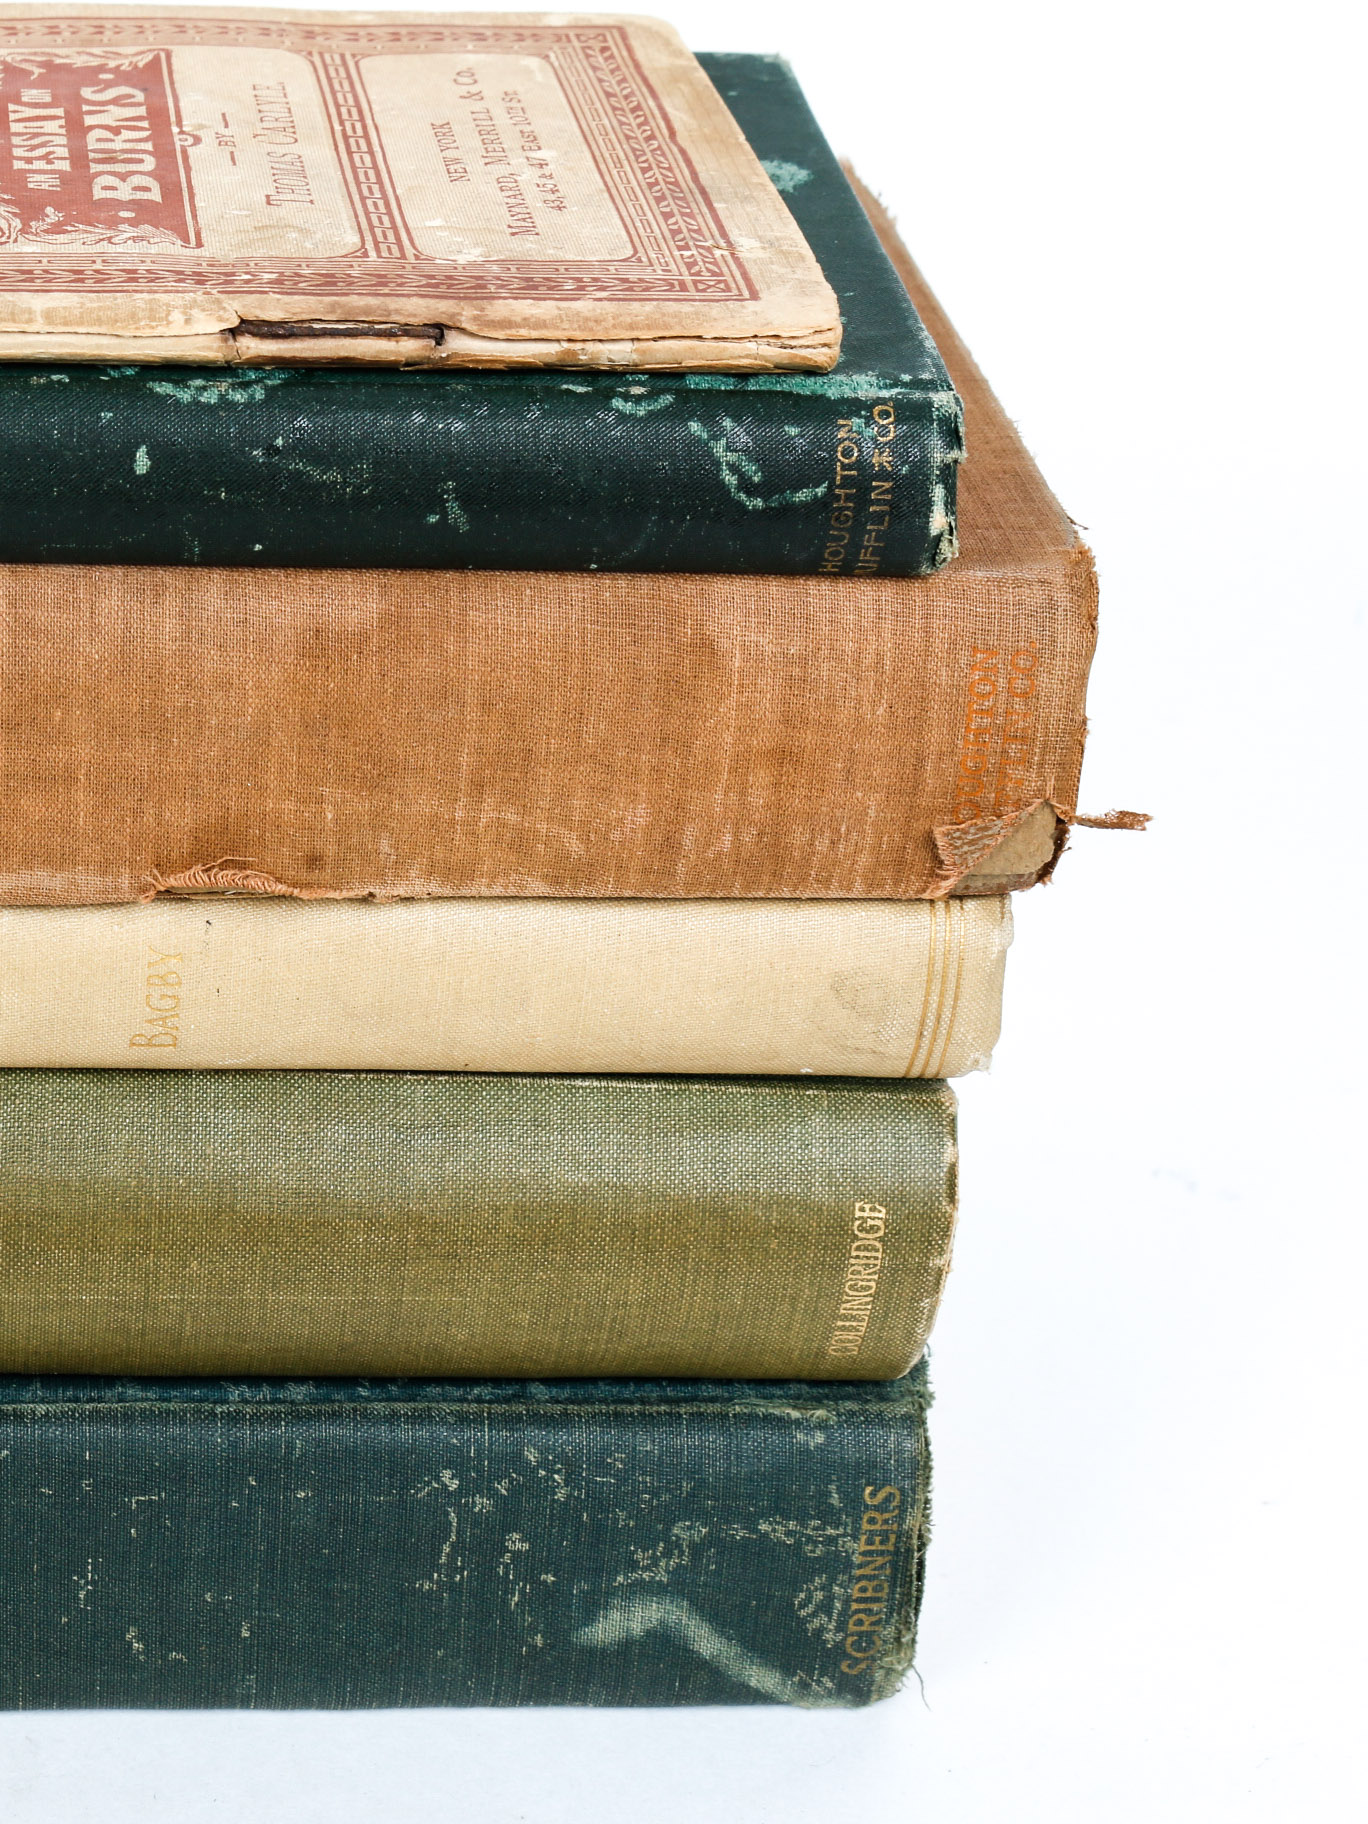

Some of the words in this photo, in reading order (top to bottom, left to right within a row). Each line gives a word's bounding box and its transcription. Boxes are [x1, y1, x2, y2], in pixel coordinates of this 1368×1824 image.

[20, 88, 52, 103] ON
[459, 90, 484, 101] &
[8, 103, 72, 172] ESSAY
[80, 84, 163, 204] BURNS
[215, 131, 237, 148] BY
[431, 121, 459, 153] YORK
[470, 107, 511, 166] MERRILL
[520, 129, 542, 152] EAST
[27, 173, 61, 191] AN
[265, 151, 315, 207] THOMAS
[442, 156, 470, 183] NEW
[525, 156, 549, 169] 47
[536, 182, 560, 194] 45
[872, 401, 895, 442] CO.
[818, 419, 860, 573] HOUGHTON
[1009, 640, 1038, 698] CO.
[952, 646, 999, 824] OUGHTON
[129, 945, 183, 1048] BAGBY
[829, 1201, 887, 1355] COLLINGRIDGE
[840, 1485, 902, 1676] SCRIBNERS
